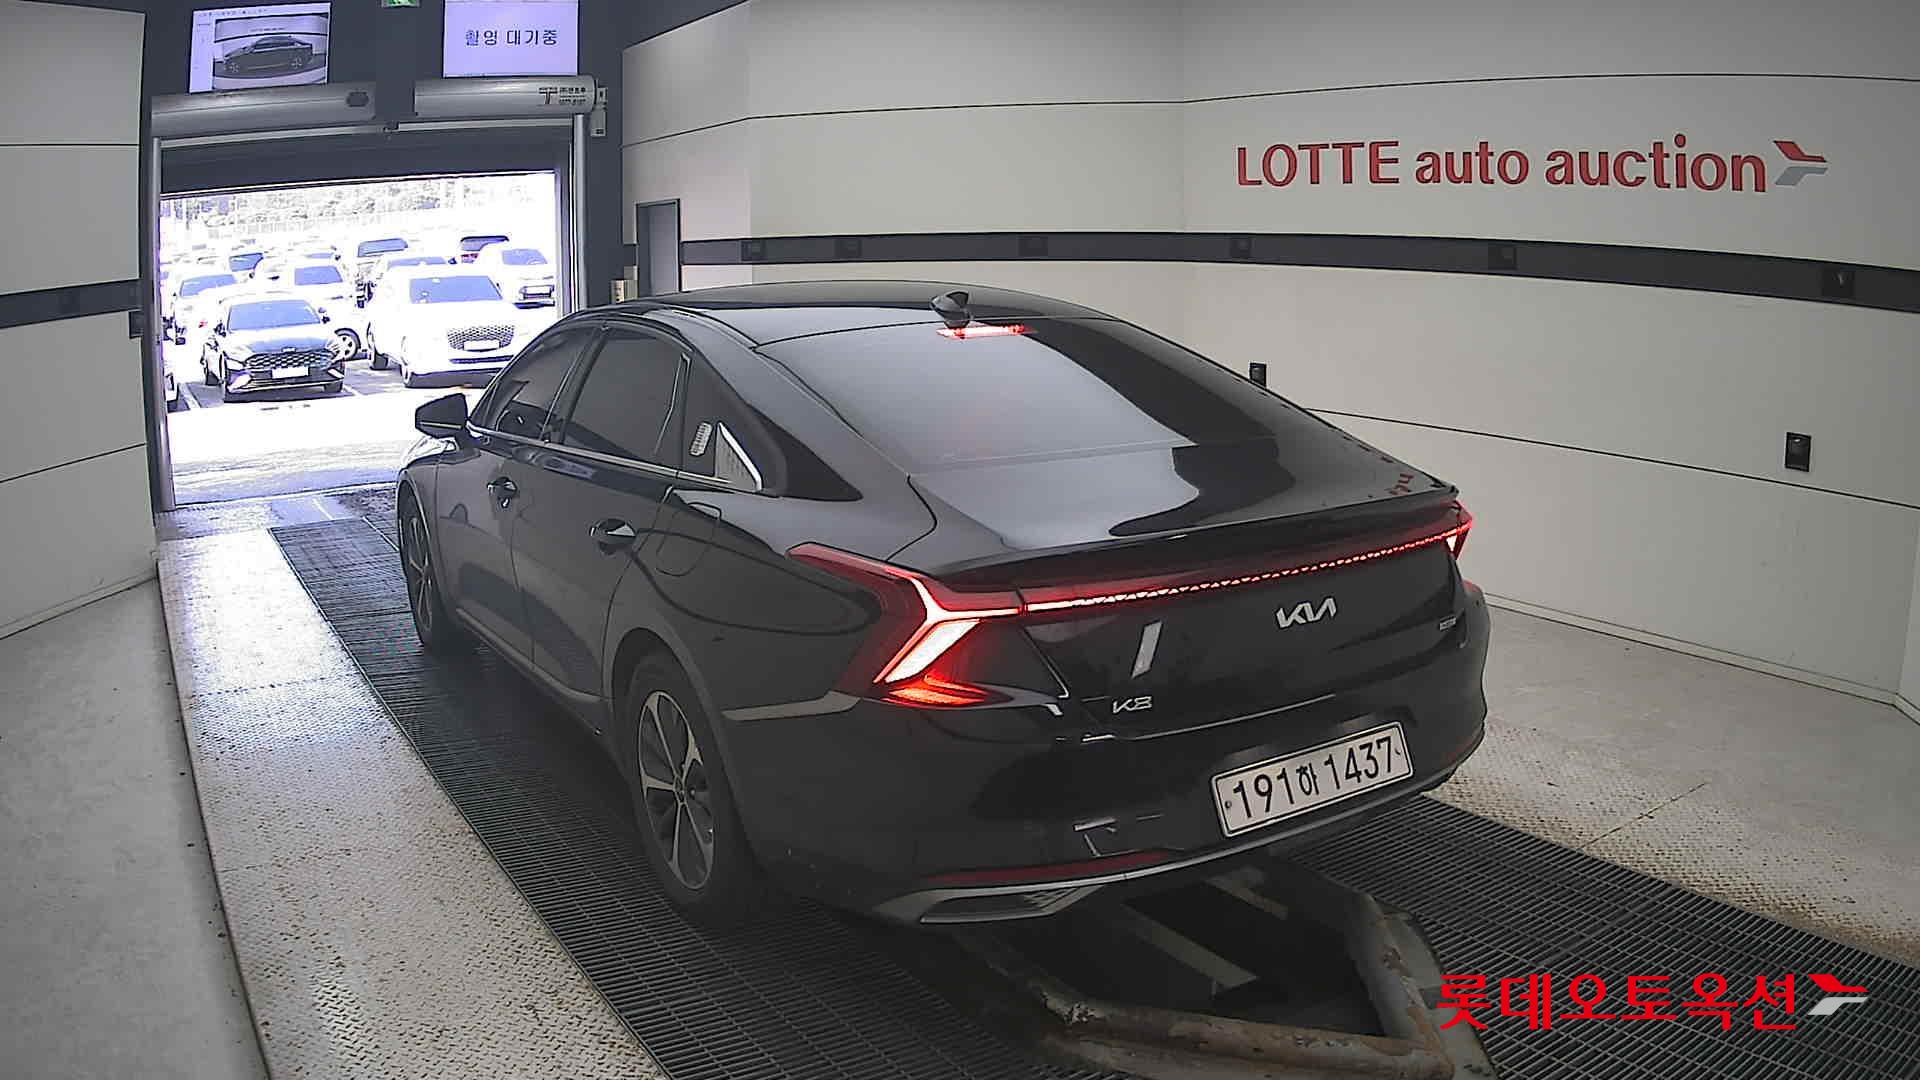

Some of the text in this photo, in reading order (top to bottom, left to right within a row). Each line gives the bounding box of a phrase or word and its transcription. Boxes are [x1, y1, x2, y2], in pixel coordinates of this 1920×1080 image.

[506, 29, 557, 46] 대기중
[1237, 134, 1767, 192] LOTTE auto auction
[1112, 697, 1152, 713] K8
[1233, 736, 1392, 818] 191하 1437
